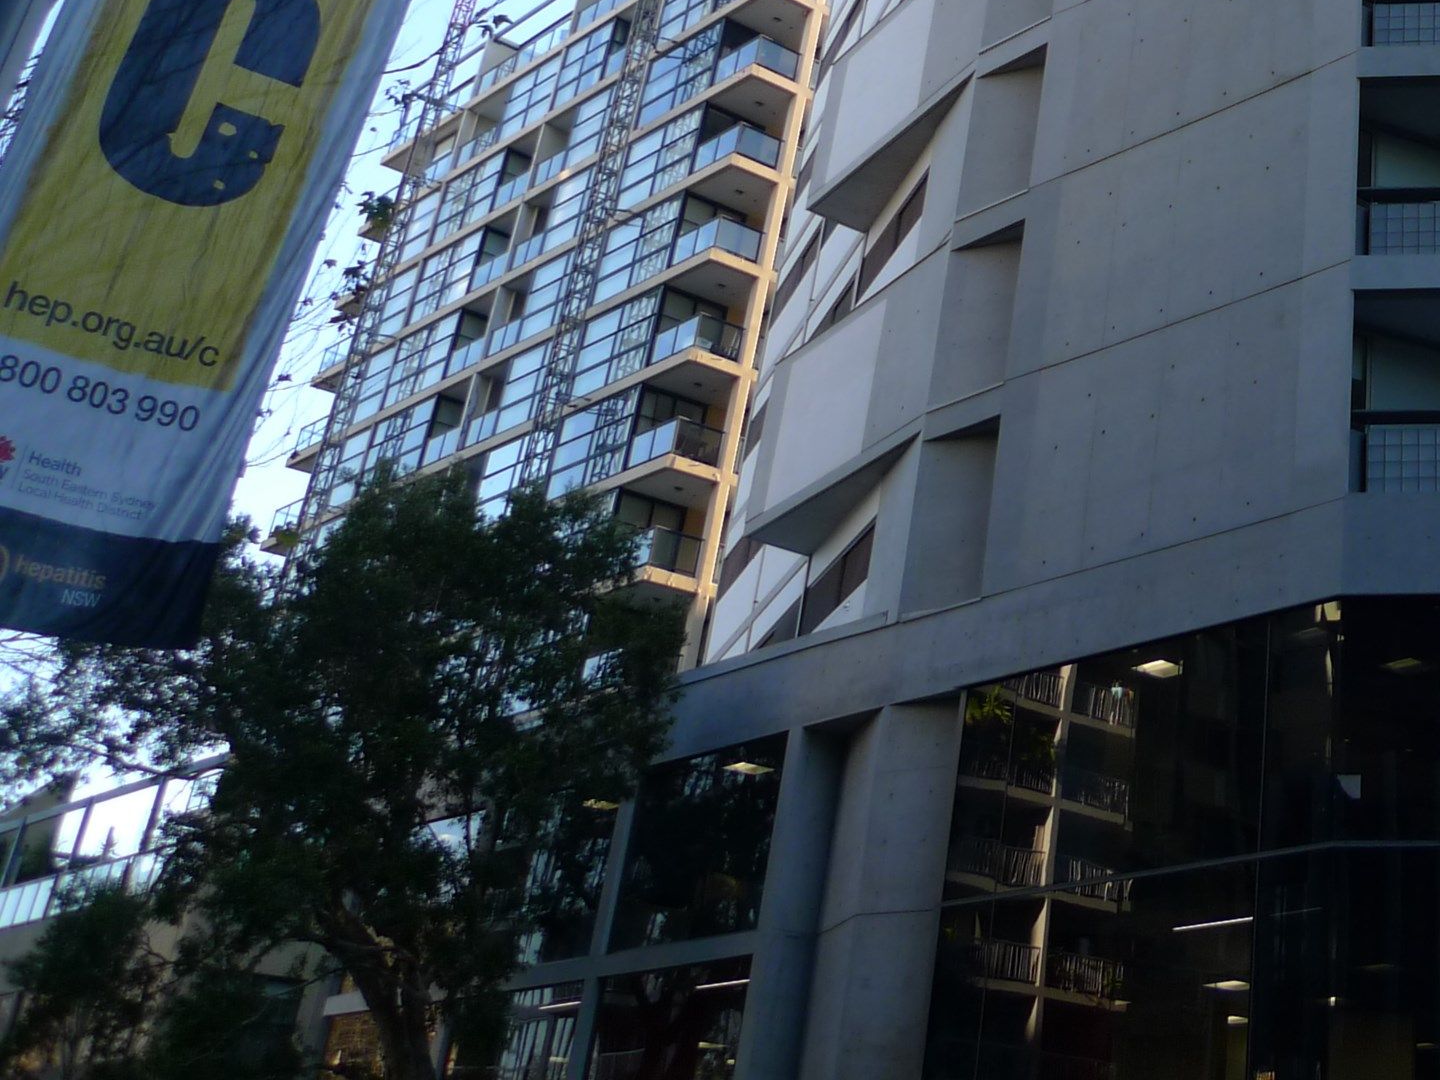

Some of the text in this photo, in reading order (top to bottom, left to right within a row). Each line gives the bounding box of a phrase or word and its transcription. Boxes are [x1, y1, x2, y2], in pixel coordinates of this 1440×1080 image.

[4, 281, 220, 367] hep.org.au/c
[0, 354, 200, 431] 800 803 990
[29, 451, 82, 477] Health
[18, 483, 144, 520] Local Health District
[24, 469, 60, 487] South
[61, 479, 108, 499] Eastern
[15, 554, 107, 590] hepatitis
[61, 589, 100, 608] NSW
